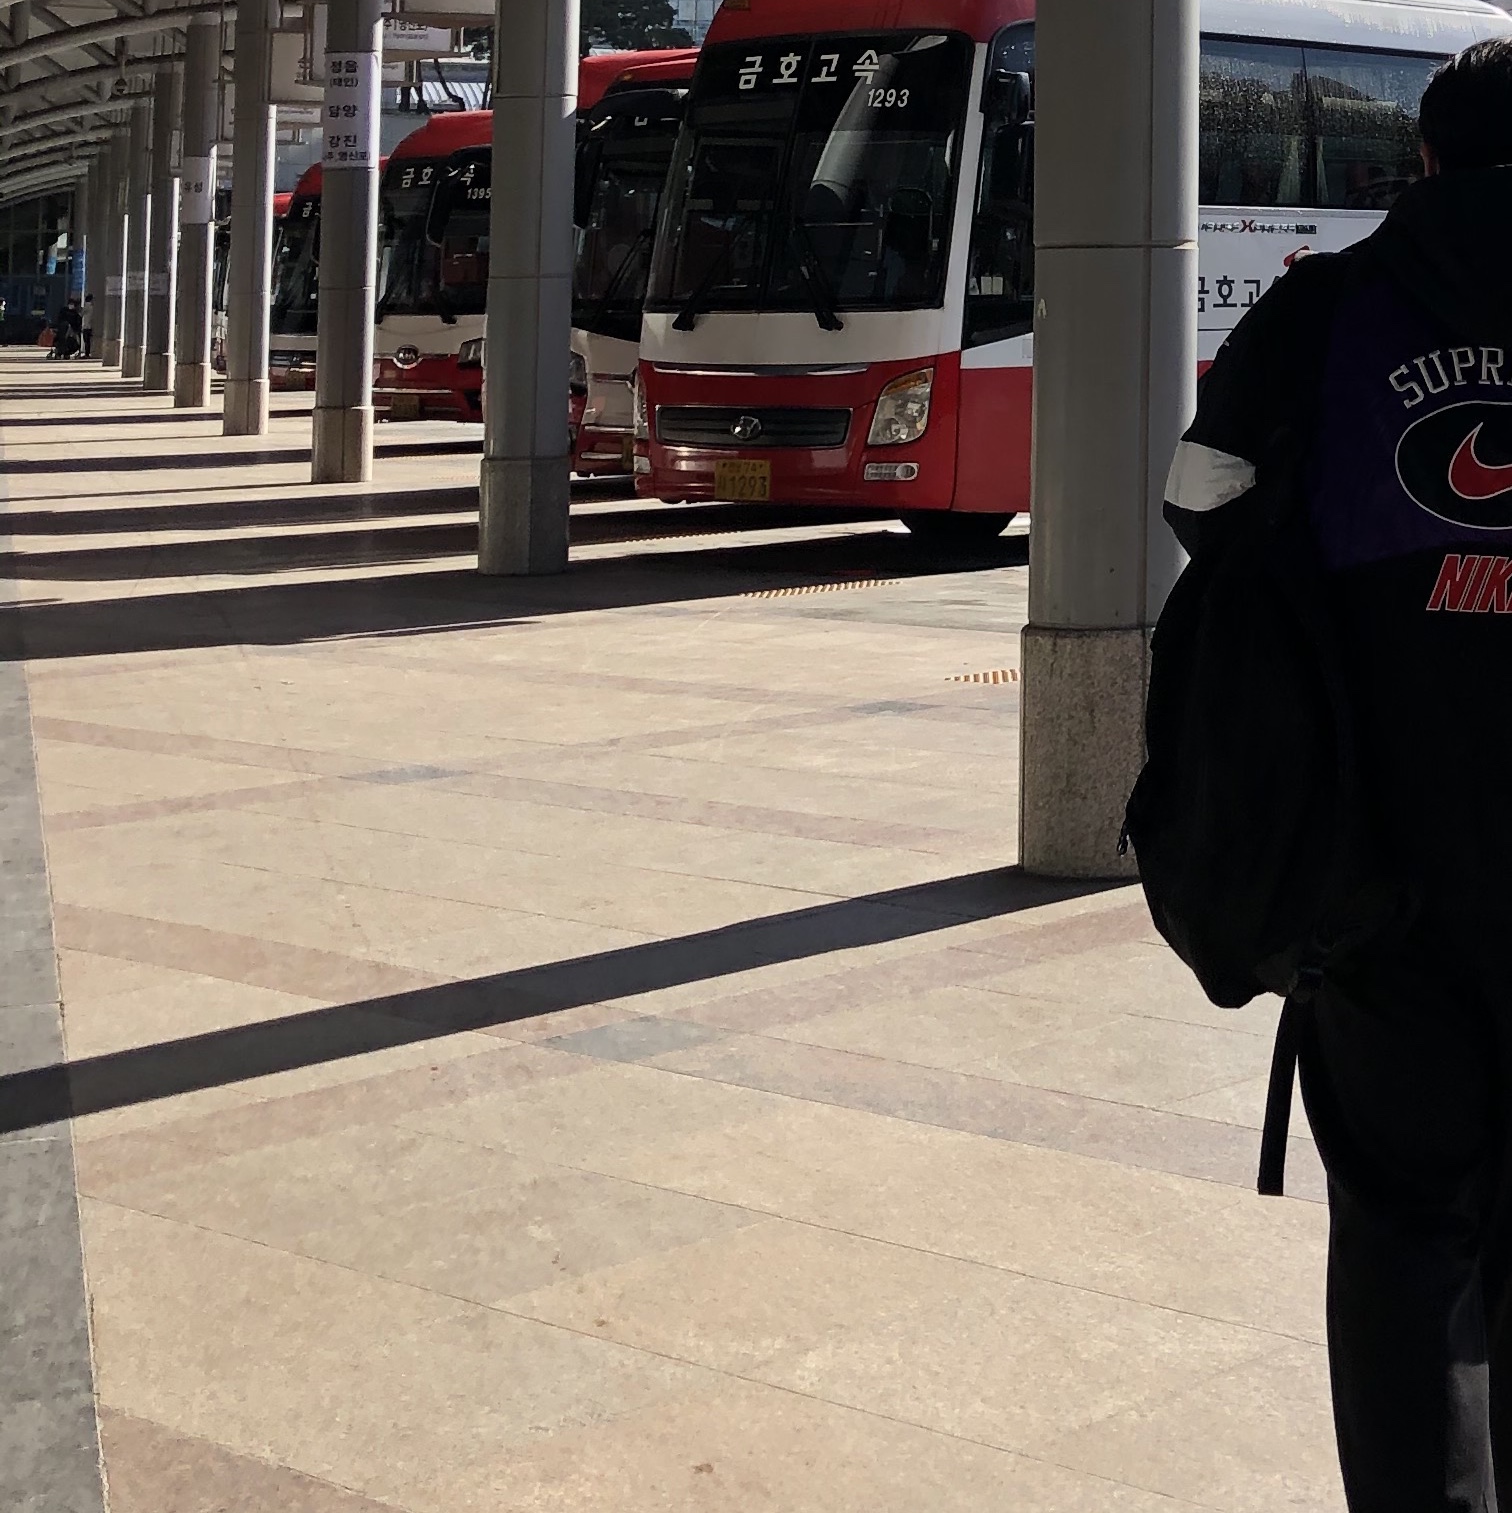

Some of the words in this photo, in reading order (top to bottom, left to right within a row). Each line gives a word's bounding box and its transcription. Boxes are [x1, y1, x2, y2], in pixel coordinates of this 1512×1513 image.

[738, 49, 880, 90] 금호고속
[868, 88, 910, 108] 1293
[328, 134, 357, 148] 강진
